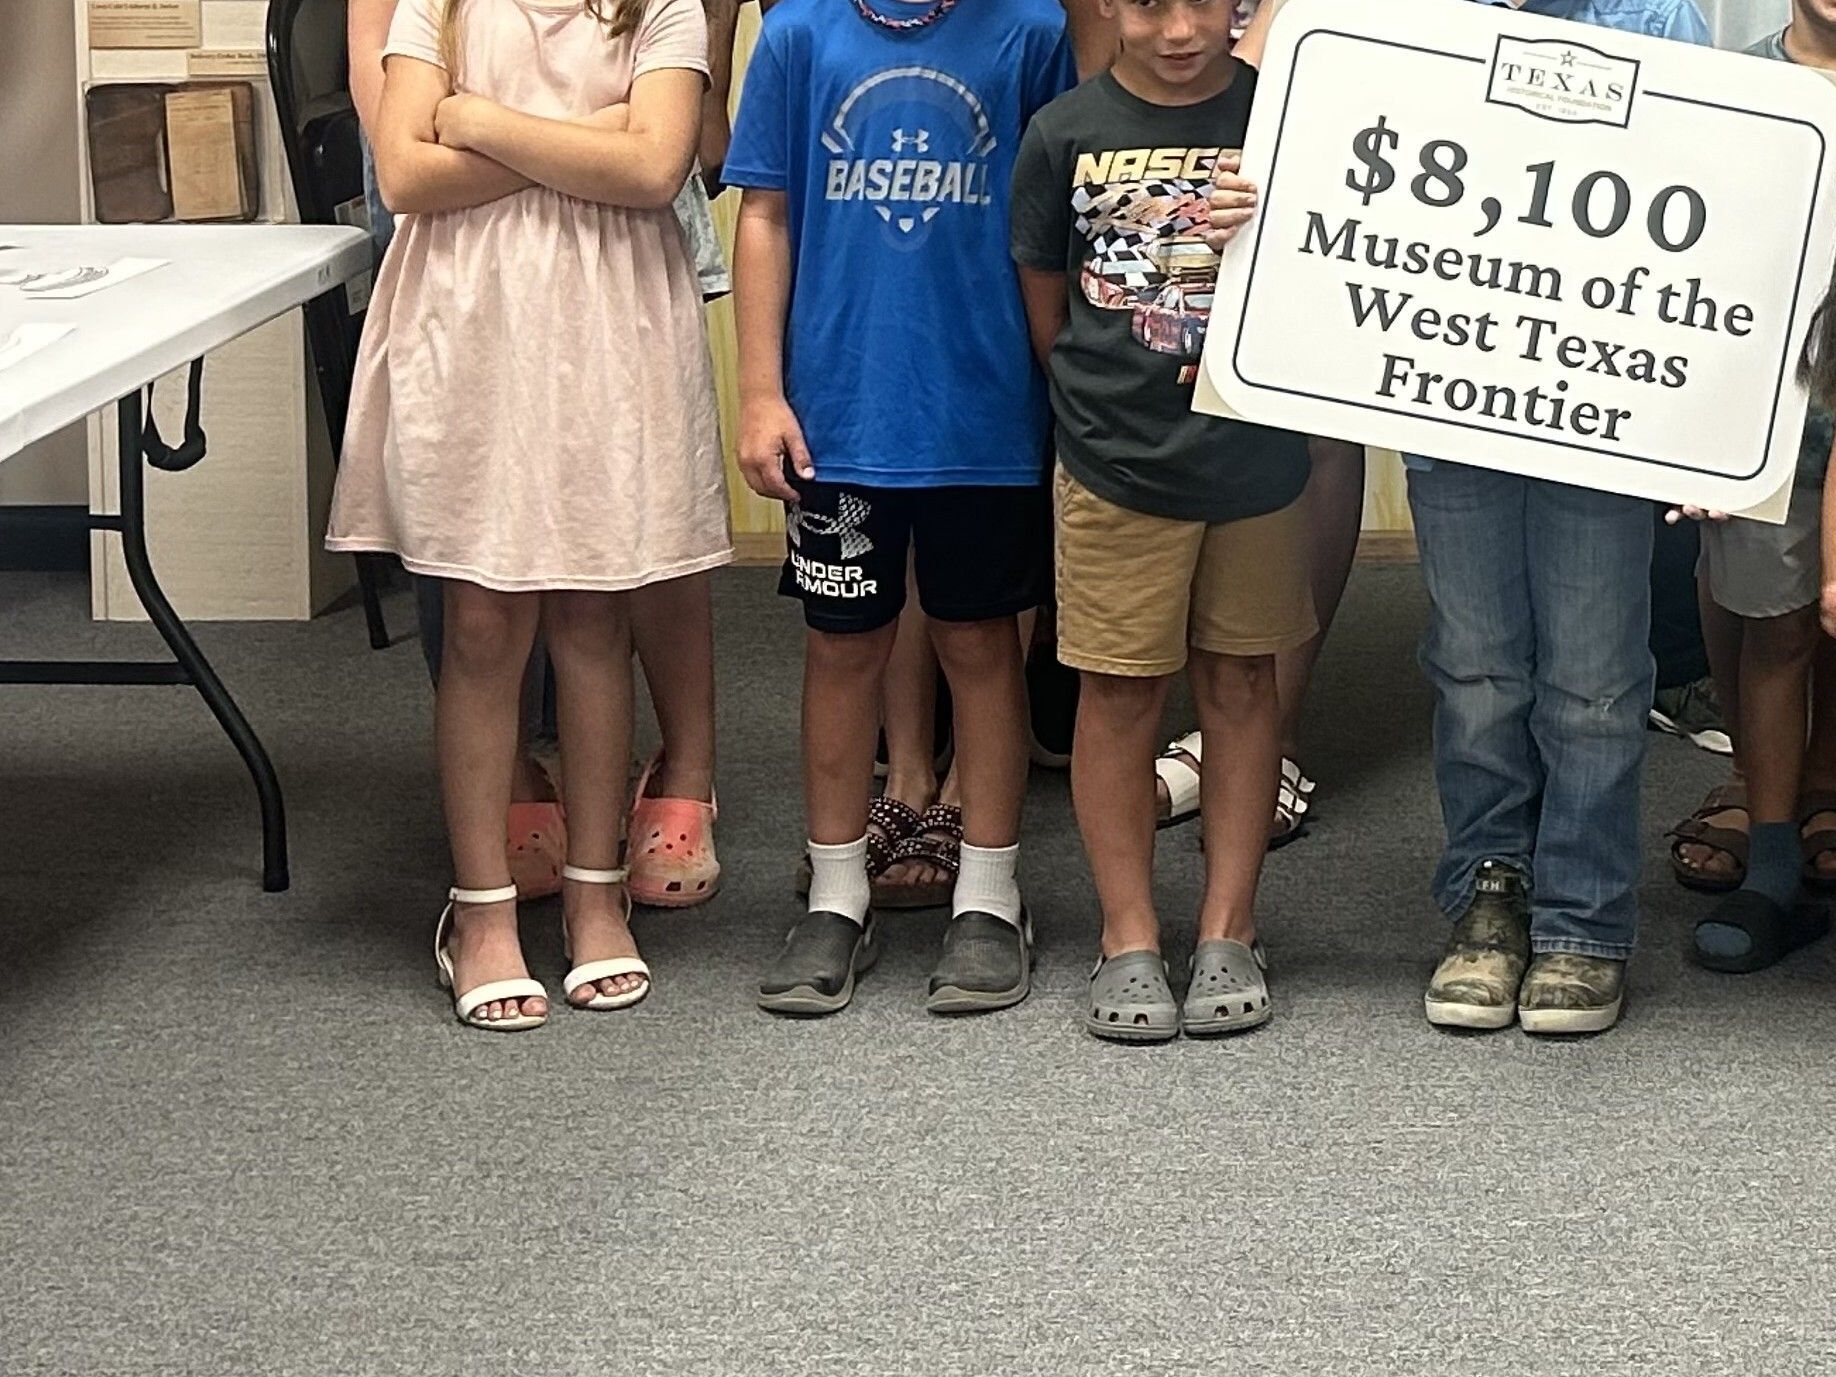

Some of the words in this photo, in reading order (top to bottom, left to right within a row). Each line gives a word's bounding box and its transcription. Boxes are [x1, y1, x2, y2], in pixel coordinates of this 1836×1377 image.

[1501, 62, 1625, 102] TEXAS
[825, 159, 992, 205] BASEBALL
[1345, 115, 1707, 253] $8,100
[1298, 211, 1563, 302] Museum
[1582, 266, 1650, 316] of
[1657, 278, 1755, 337] the
[1344, 282, 1499, 352] West
[1516, 315, 1689, 388] Texas
[1376, 353, 1632, 442] Frontier
[791, 549, 863, 582] UNDER
